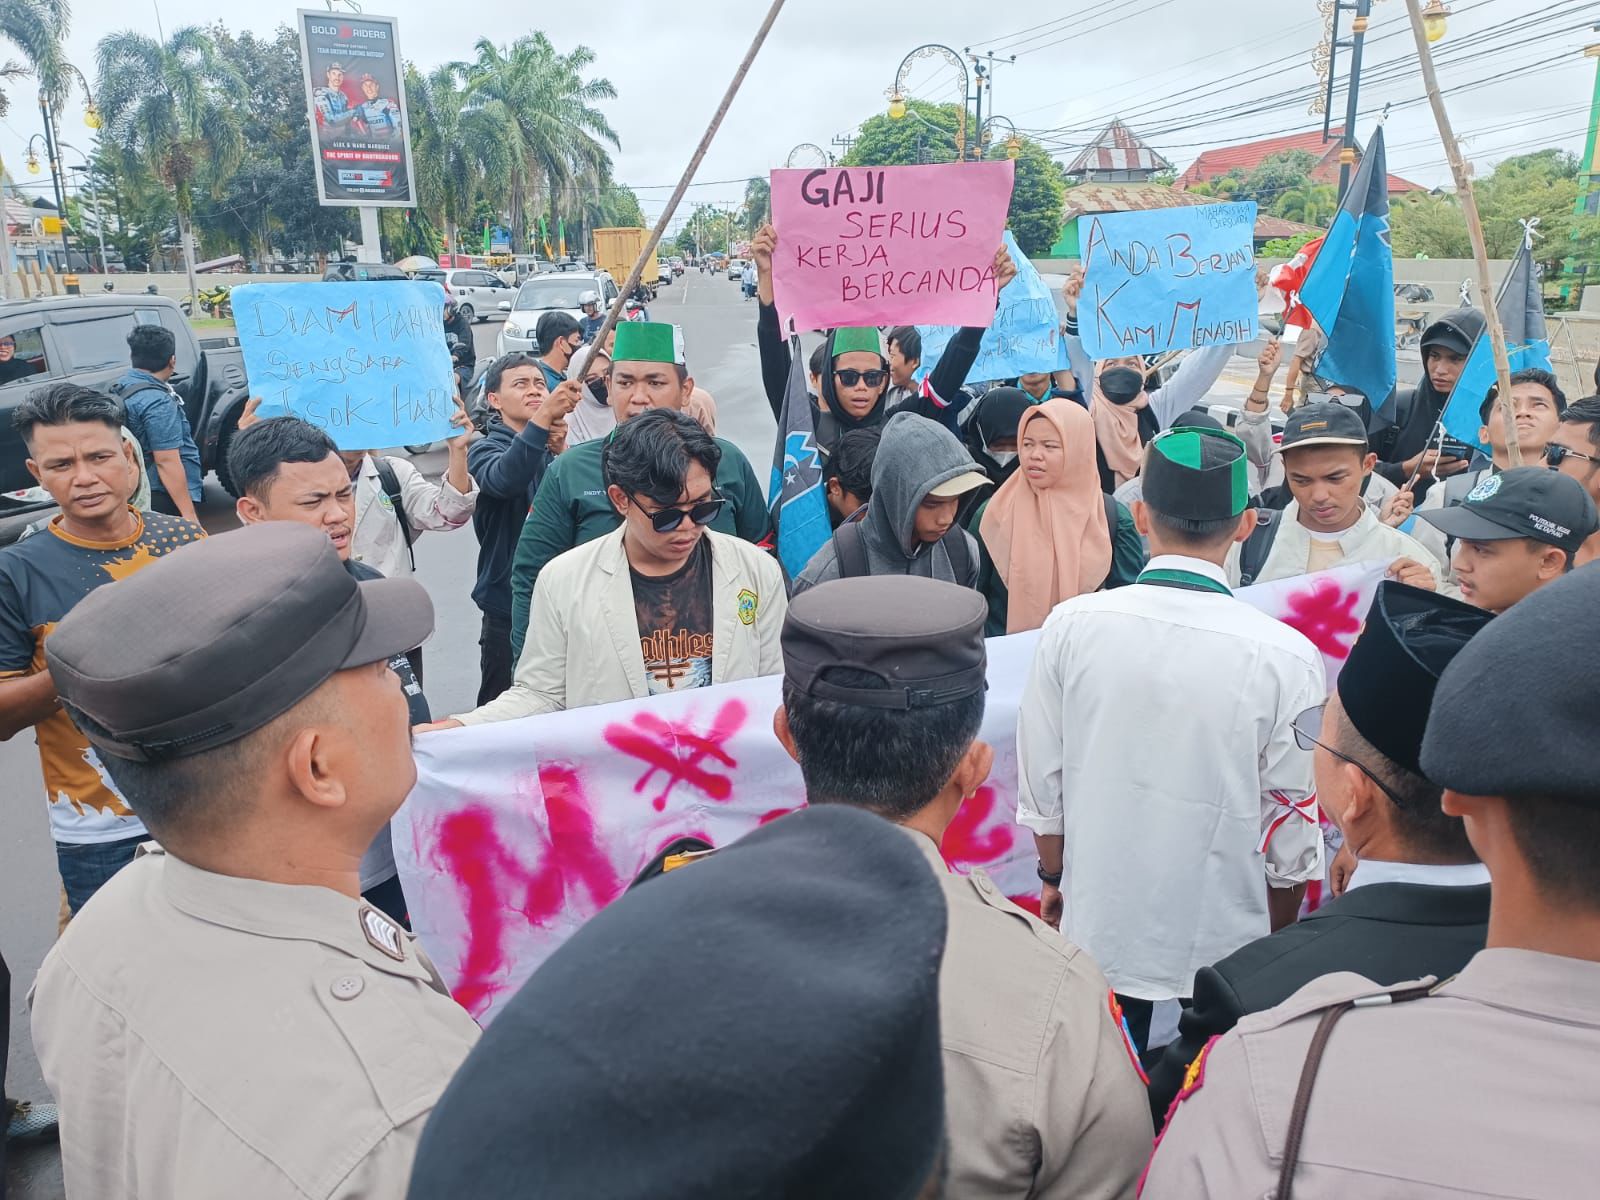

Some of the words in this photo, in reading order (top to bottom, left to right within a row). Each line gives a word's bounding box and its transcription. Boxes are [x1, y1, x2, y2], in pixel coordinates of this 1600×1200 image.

[312, 25, 337, 35] BOLD
[353, 28, 386, 39] RIDERS
[801, 169, 885, 208] GAJI
[839, 209, 967, 239] SERIUS
[797, 244, 889, 268] KERJA
[1083, 217, 1161, 279] ANDA
[843, 266, 997, 302] BERCANDA
[254, 300, 360, 337] DIAM
[1095, 279, 1162, 350] KAMI
[1166, 298, 1252, 348] MENAGIH
